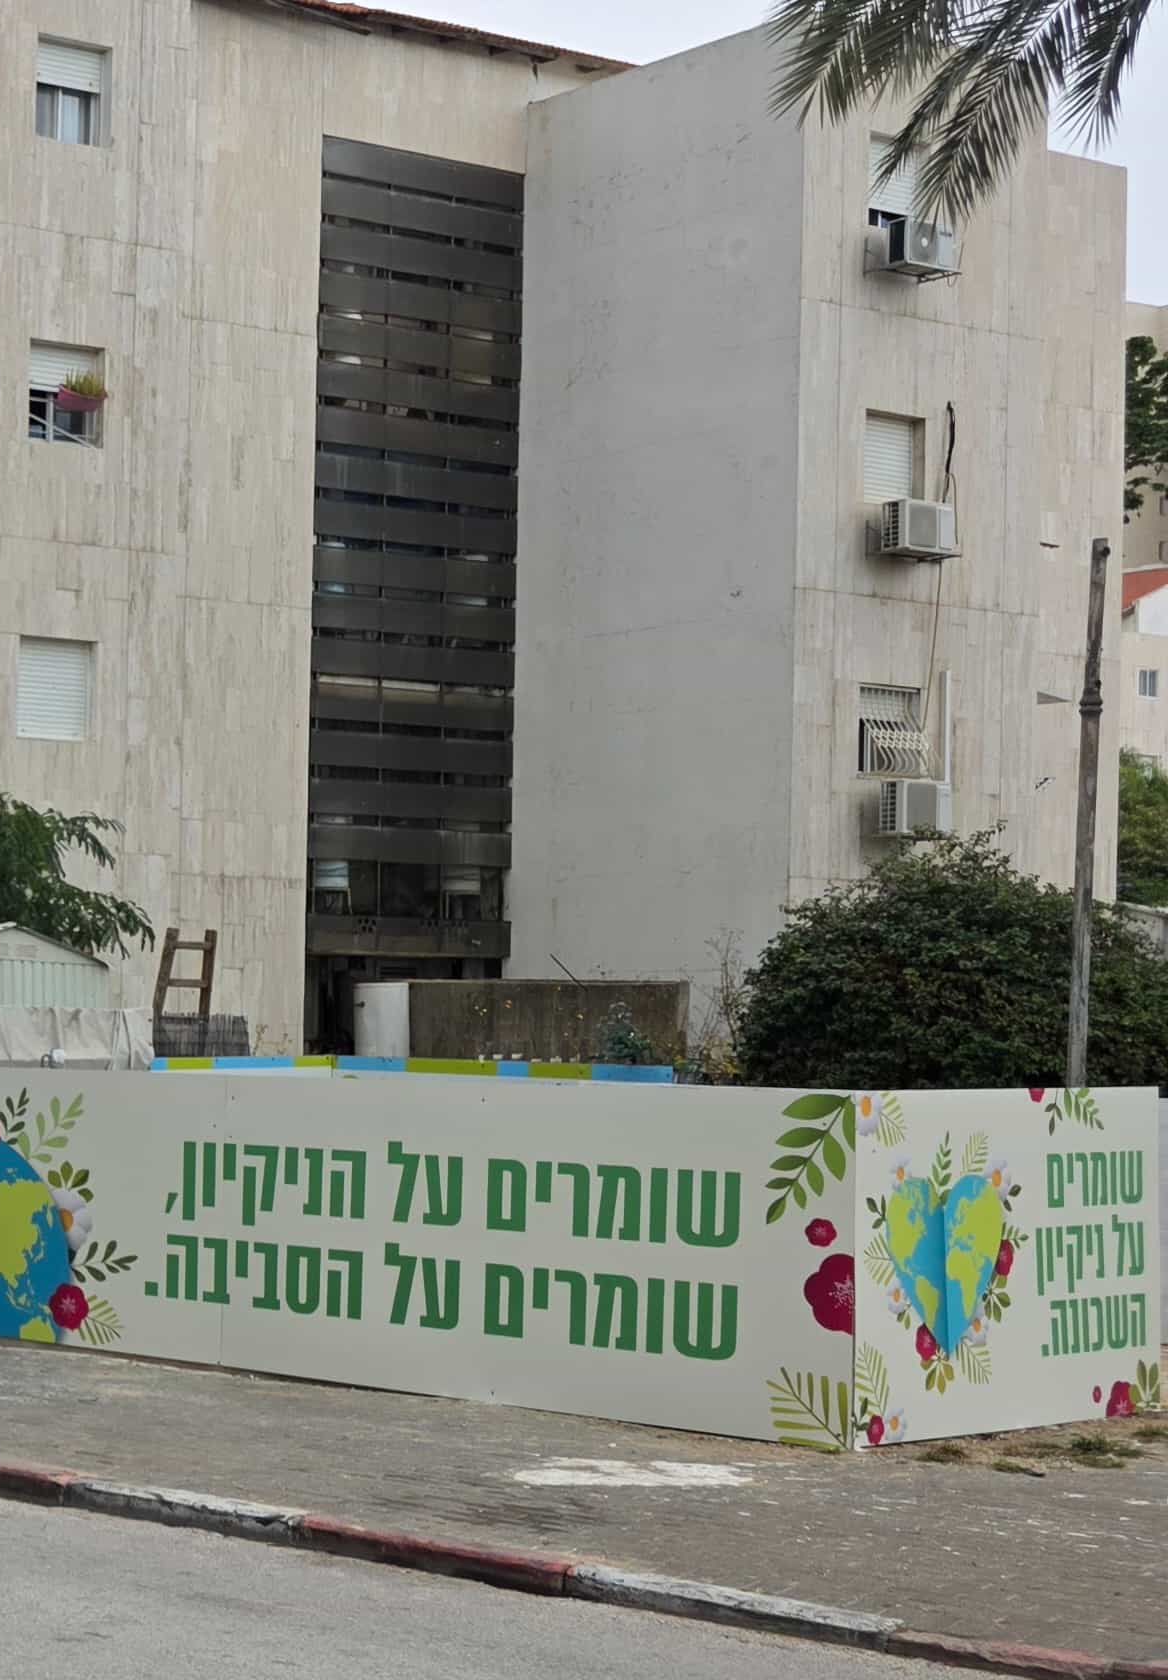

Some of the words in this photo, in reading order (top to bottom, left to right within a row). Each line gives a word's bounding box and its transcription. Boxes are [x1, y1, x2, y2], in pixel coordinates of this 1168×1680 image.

[164, 1140, 367, 1226] הניקיון,
[387, 1140, 464, 1227] על
[485, 1157, 742, 1249] שומרים
[1046, 1150, 1145, 1209] שומרים
[143, 1233, 364, 1321] הסביבה.
[384, 1242, 461, 1331] על
[1035, 1223, 1105, 1297] ניקיון
[1111, 1213, 1145, 1278] על
[483, 1262, 739, 1361] שומרים
[1040, 1292, 1147, 1358] השכונה.
